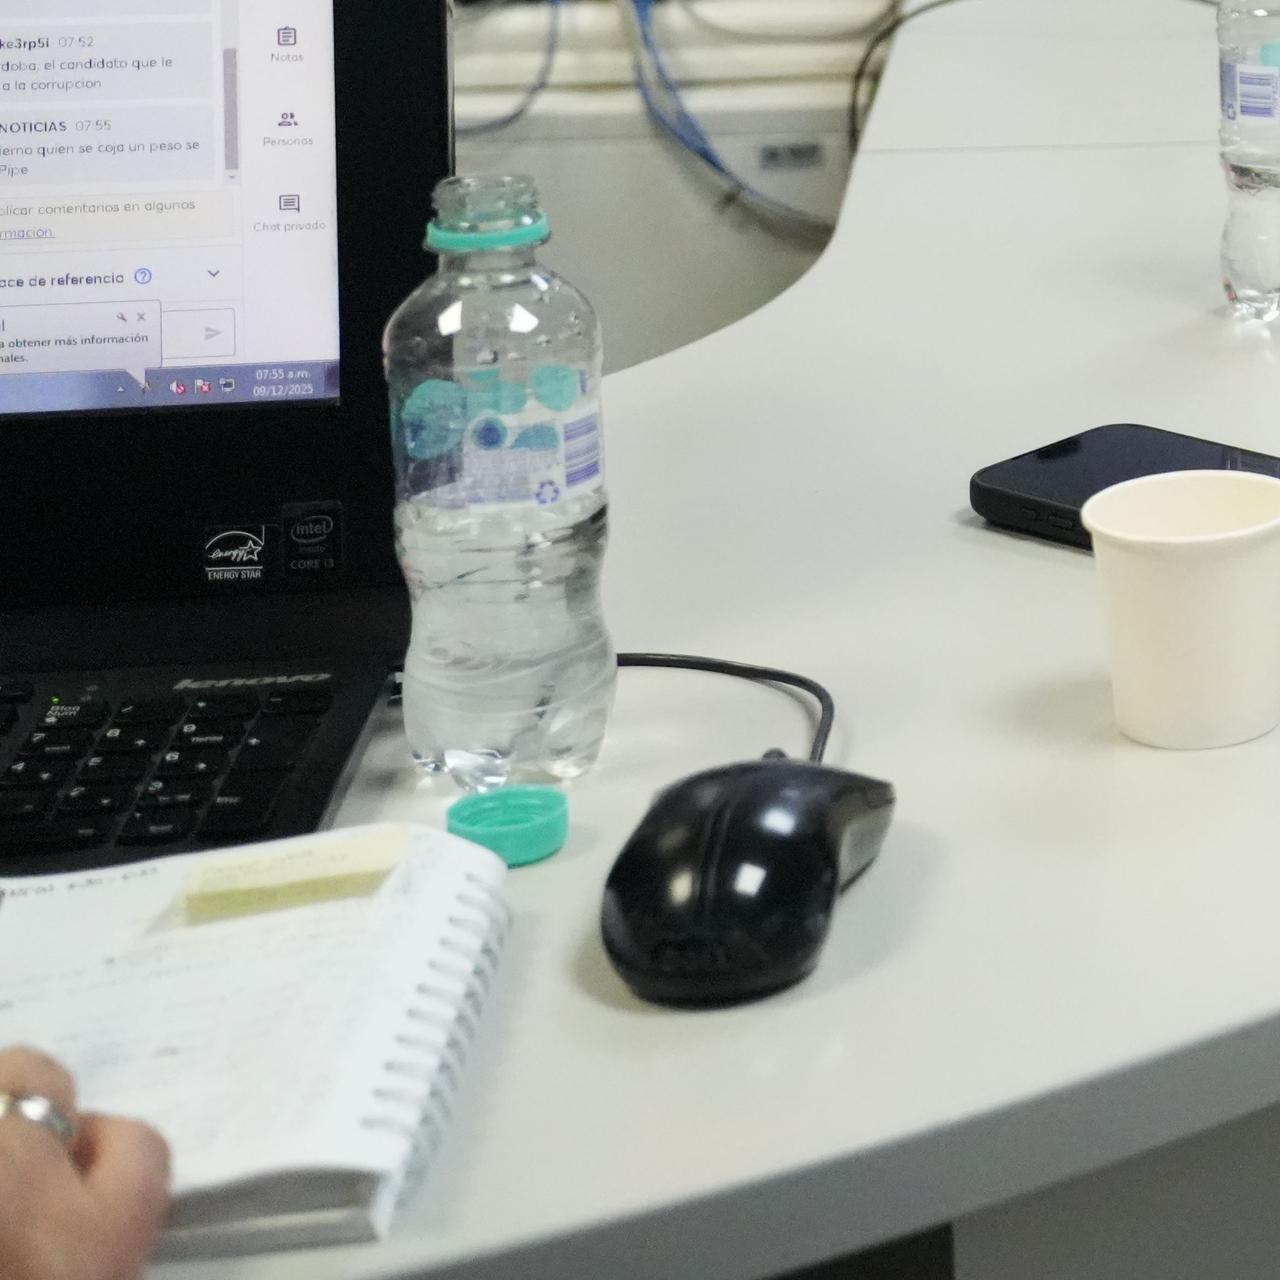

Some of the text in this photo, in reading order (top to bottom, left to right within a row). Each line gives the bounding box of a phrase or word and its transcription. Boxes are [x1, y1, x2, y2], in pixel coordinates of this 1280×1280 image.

[271, 52, 304, 63] Notas
[44, 60, 56, 70] el
[59, 58, 128, 70] candidato
[131, 58, 157, 71] que
[78, 144, 93, 154] se
[128, 142, 145, 152] un
[149, 141, 183, 154] peso
[185, 140, 200, 151] se
[263, 136, 314, 146] Personas
[38, 200, 120, 214] comentarios
[123, 202, 140, 212] en
[144, 199, 196, 214] algunos
[253, 220, 327, 233] Chat privado
[29, 273, 47, 287] de
[51, 272, 125, 286] referencia
[8, 333, 149, 349] obtener más información
[256, 369, 285, 380] 07:55
[253, 383, 314, 396] 09/12/2025
[296, 521, 329, 535] intel
[208, 570, 262, 581] ENERGY STAR
